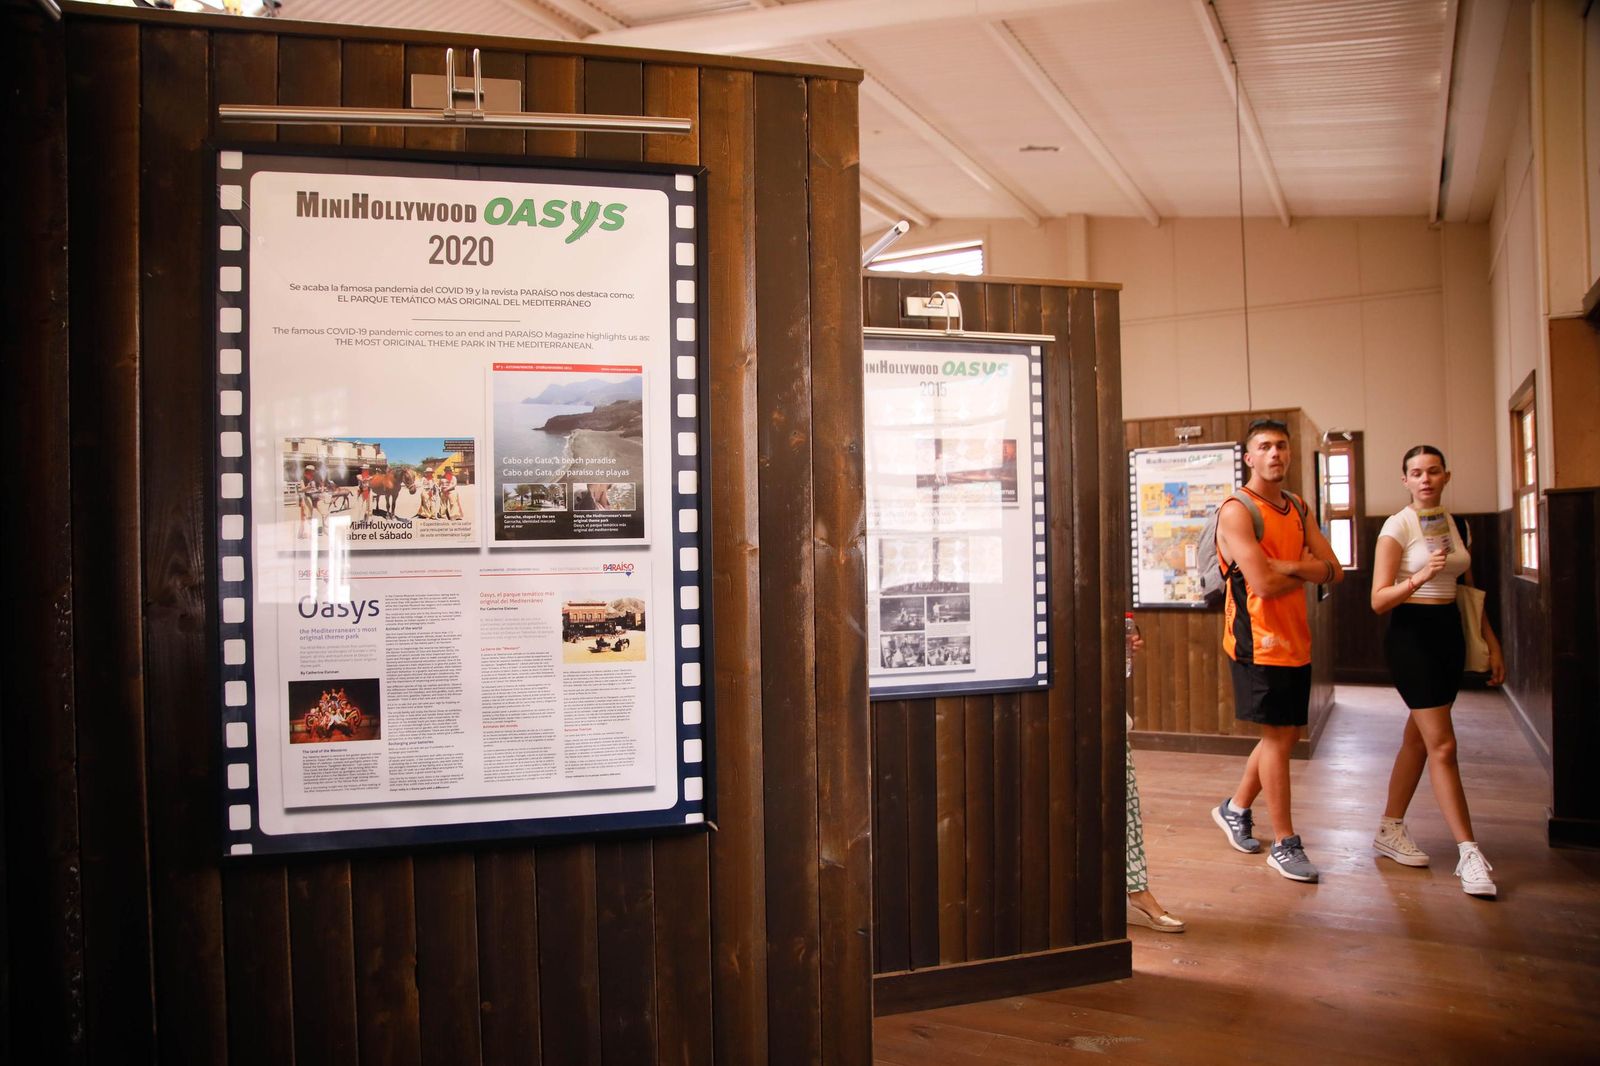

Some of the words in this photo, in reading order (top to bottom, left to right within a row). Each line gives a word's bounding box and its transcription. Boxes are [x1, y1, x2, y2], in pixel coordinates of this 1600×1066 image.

[484, 197, 628, 244] OASYS
[428, 235, 494, 266] 2020
[331, 284, 339, 292] la
[340, 284, 373, 293] famosa
[374, 284, 418, 296] pandemia
[475, 289, 480, 297] y
[520, 287, 558, 297] PARAÍSO
[576, 290, 608, 298] destaca
[350, 295, 389, 304] PARQUE
[390, 294, 436, 304] TEMÁTICO
[438, 296, 458, 304] MÁS
[459, 298, 501, 306] ORIGINAL
[522, 298, 591, 308] MEDITERRÁNEO
[272, 327, 289, 335] The
[291, 327, 324, 335] famous
[326, 327, 367, 336] COVID-19
[369, 328, 413, 338] pandemic
[504, 329, 543, 338] PARAÍSO
[545, 331, 585, 340] Magazine
[586, 332, 627, 342] highlights
[382, 339, 426, 347] ORIGINAL
[517, 341, 594, 350] MEDITERRANEAN.
[866, 360, 938, 375] INIHOLLYWOOD
[585, 457, 617, 466] paradise
[535, 469, 555, 477] Gata,
[606, 469, 630, 478] playas
[348, 521, 413, 531] MiniHollywood
[346, 531, 367, 540] abre
[369, 530, 377, 540] el
[379, 530, 412, 540] sábado
[298, 595, 380, 624] Oasys
